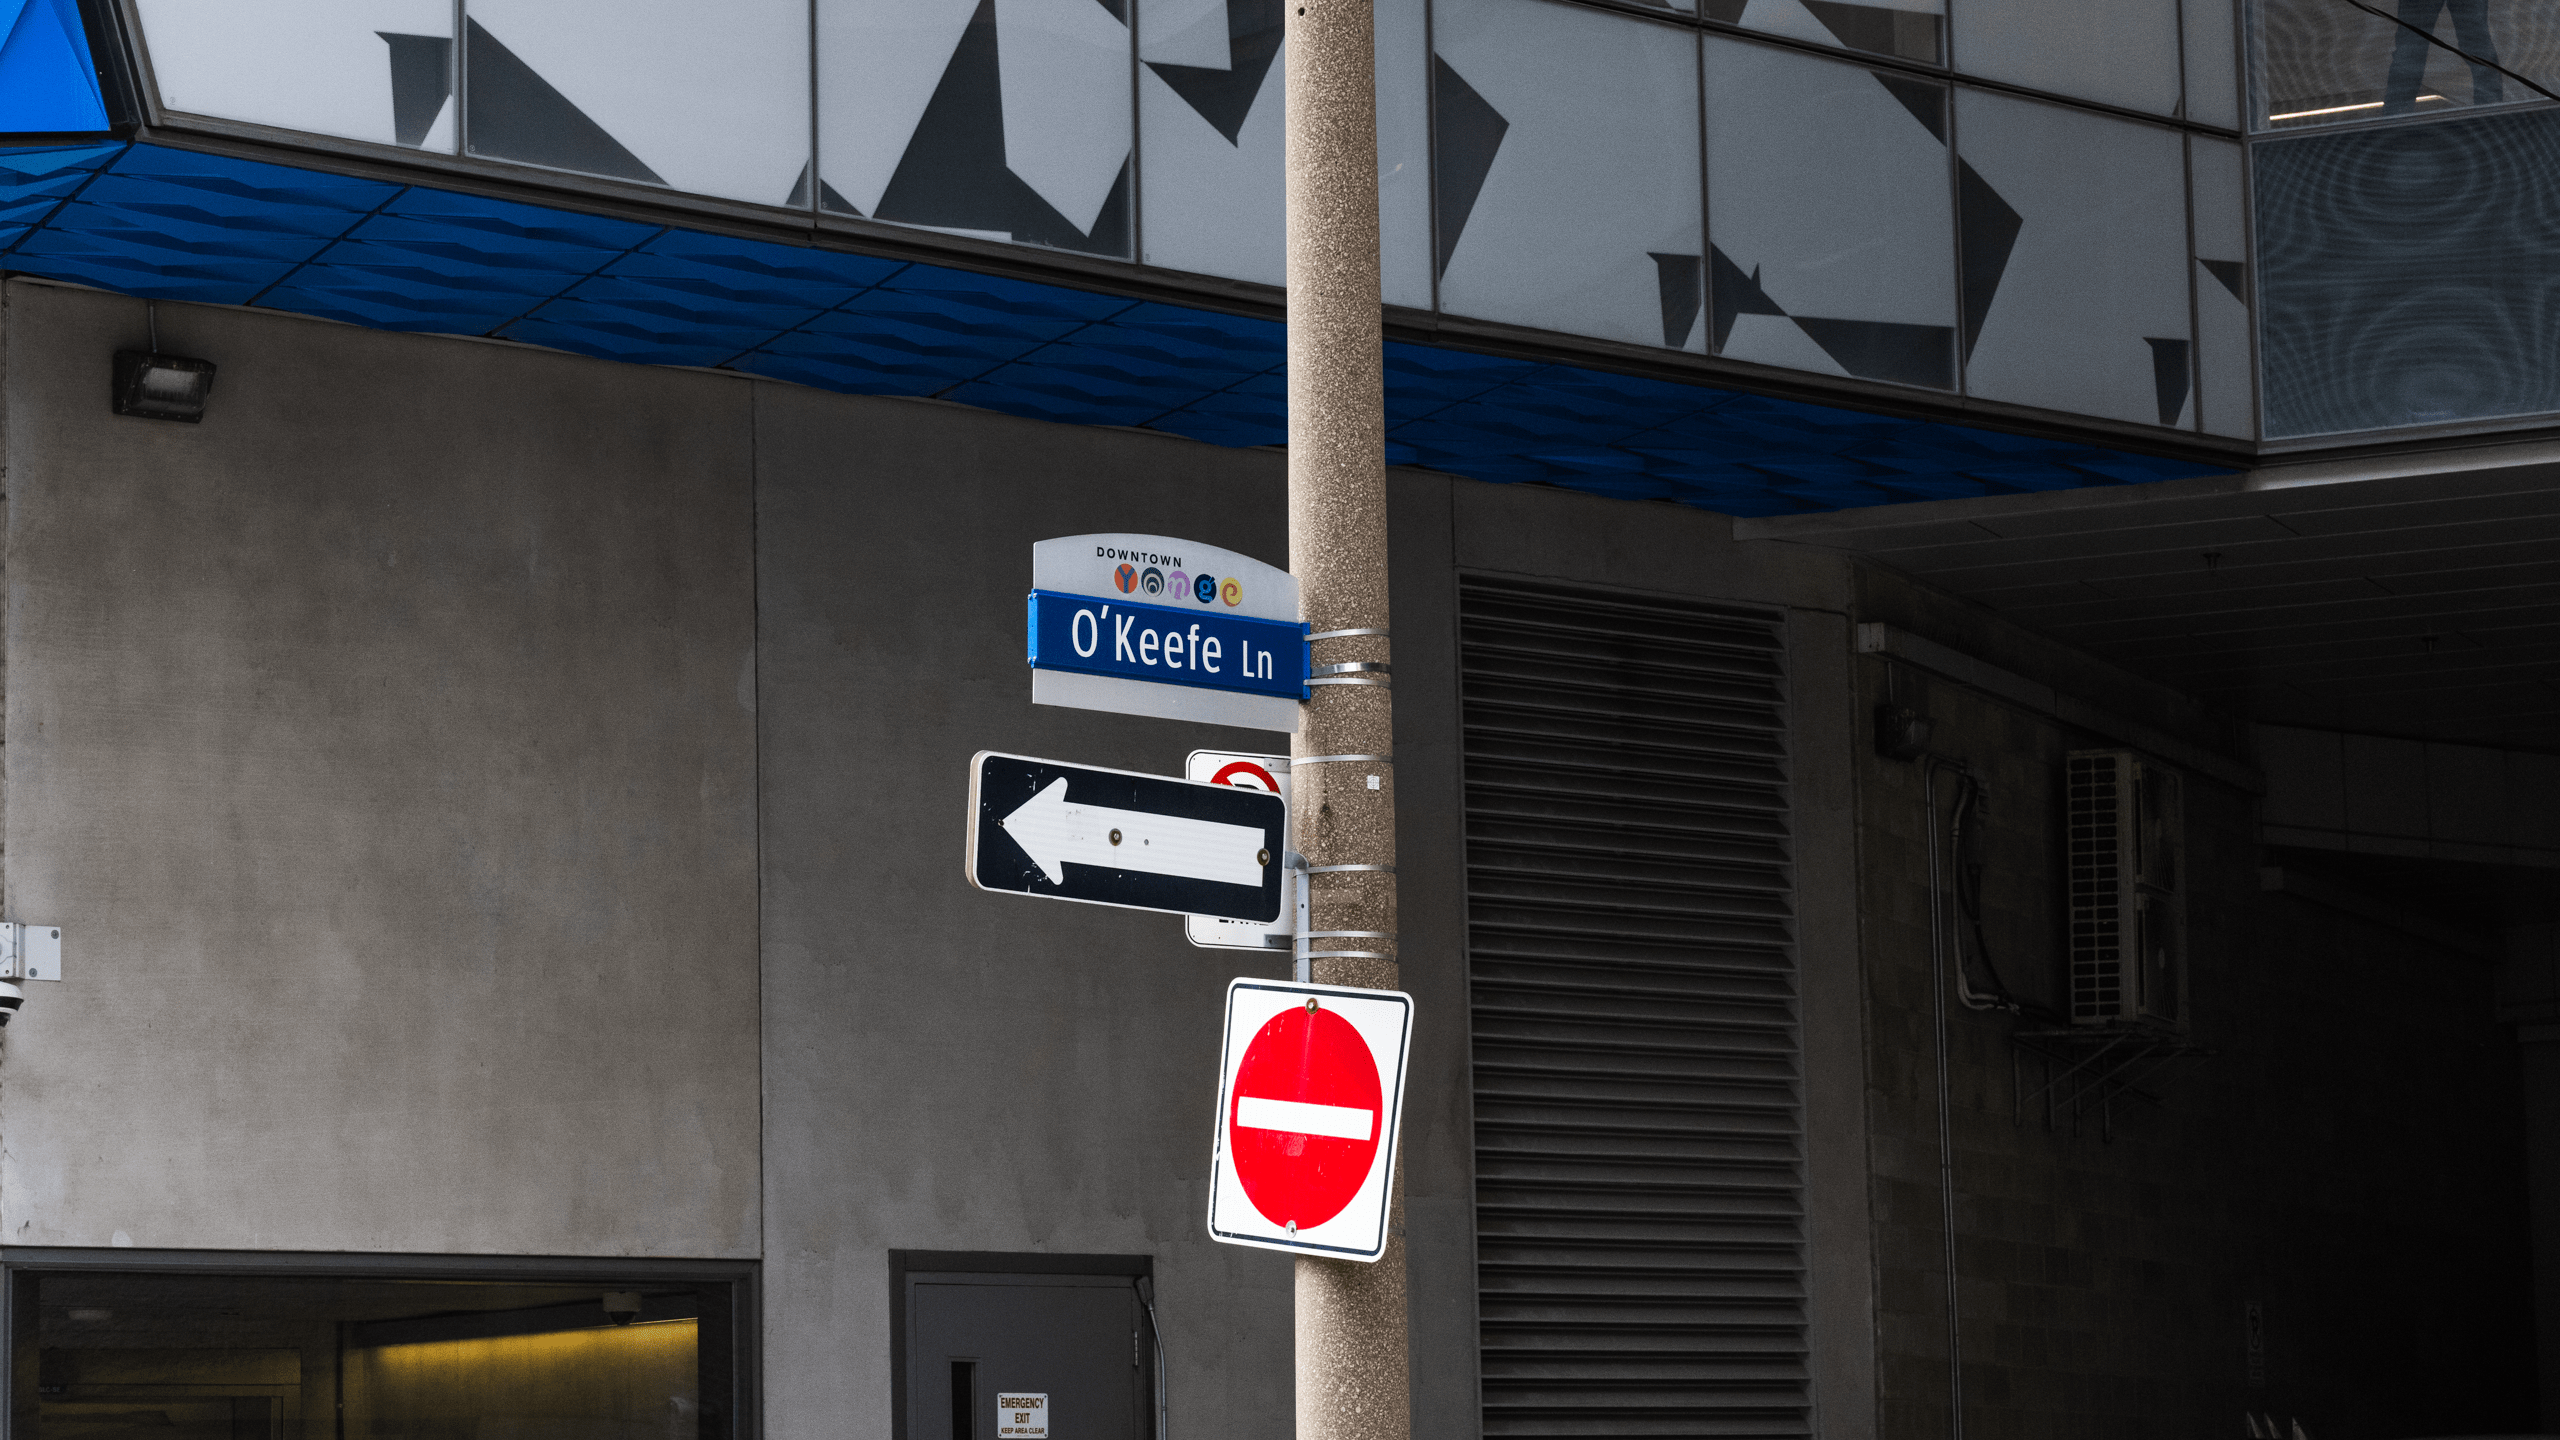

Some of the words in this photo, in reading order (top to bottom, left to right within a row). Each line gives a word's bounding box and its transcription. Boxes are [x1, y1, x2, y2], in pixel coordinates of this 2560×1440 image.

[1096, 546, 1182, 568] DOWNTOWN
[1071, 604, 1223, 674] O'Keefe
[1242, 639, 1273, 680] Ln
[1000, 1397, 1044, 1409] EMERGENCY
[1014, 1412, 1031, 1424] EXIT
